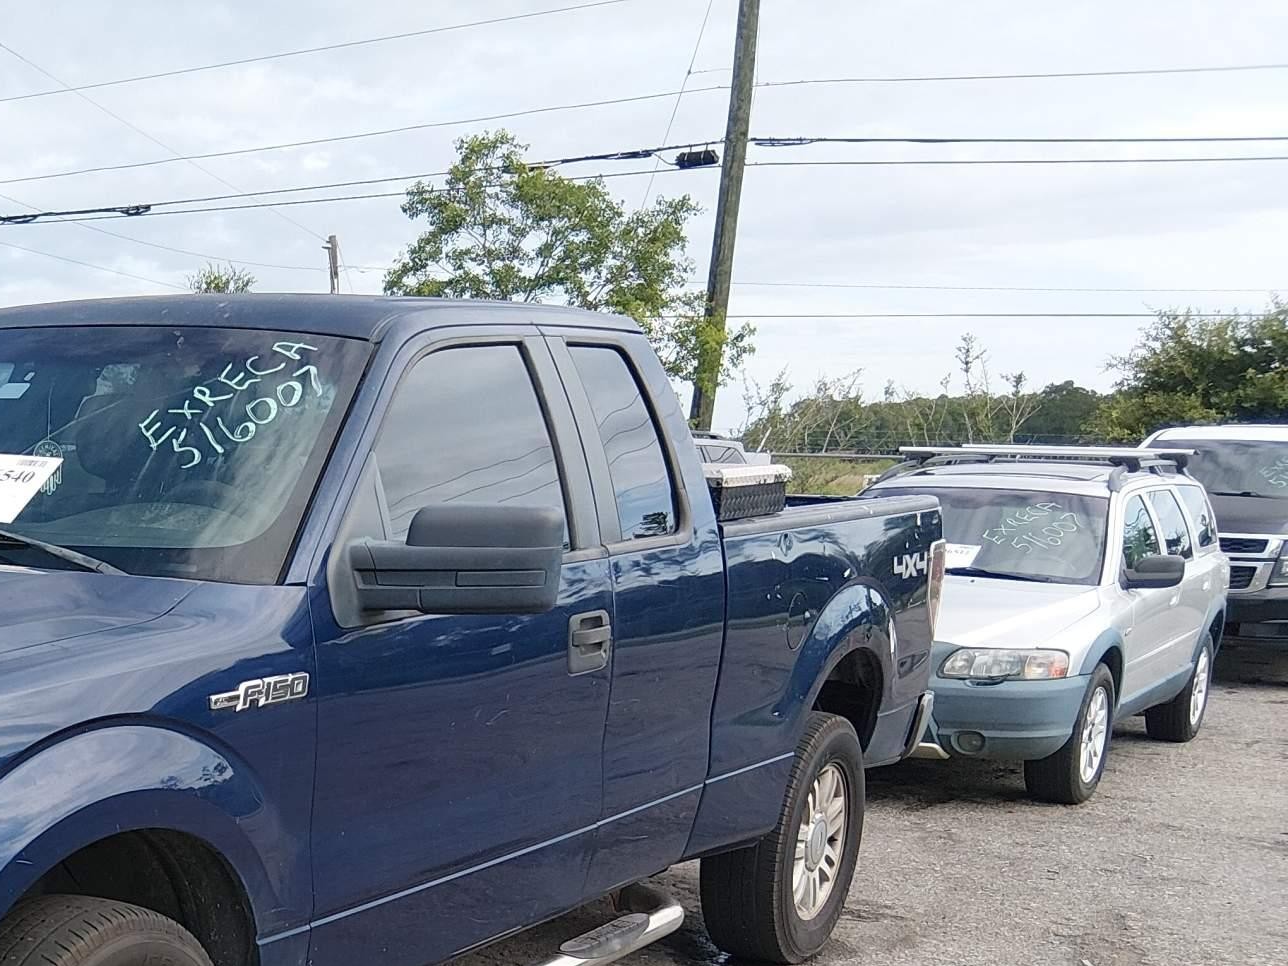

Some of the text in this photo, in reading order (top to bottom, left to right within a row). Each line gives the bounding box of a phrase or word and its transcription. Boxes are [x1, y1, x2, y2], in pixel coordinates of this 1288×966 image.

[139, 341, 318, 450] EXRECA
[172, 364, 323, 469] 516007
[982, 501, 1063, 545] EXRECA
[1011, 512, 1086, 554] 516007
